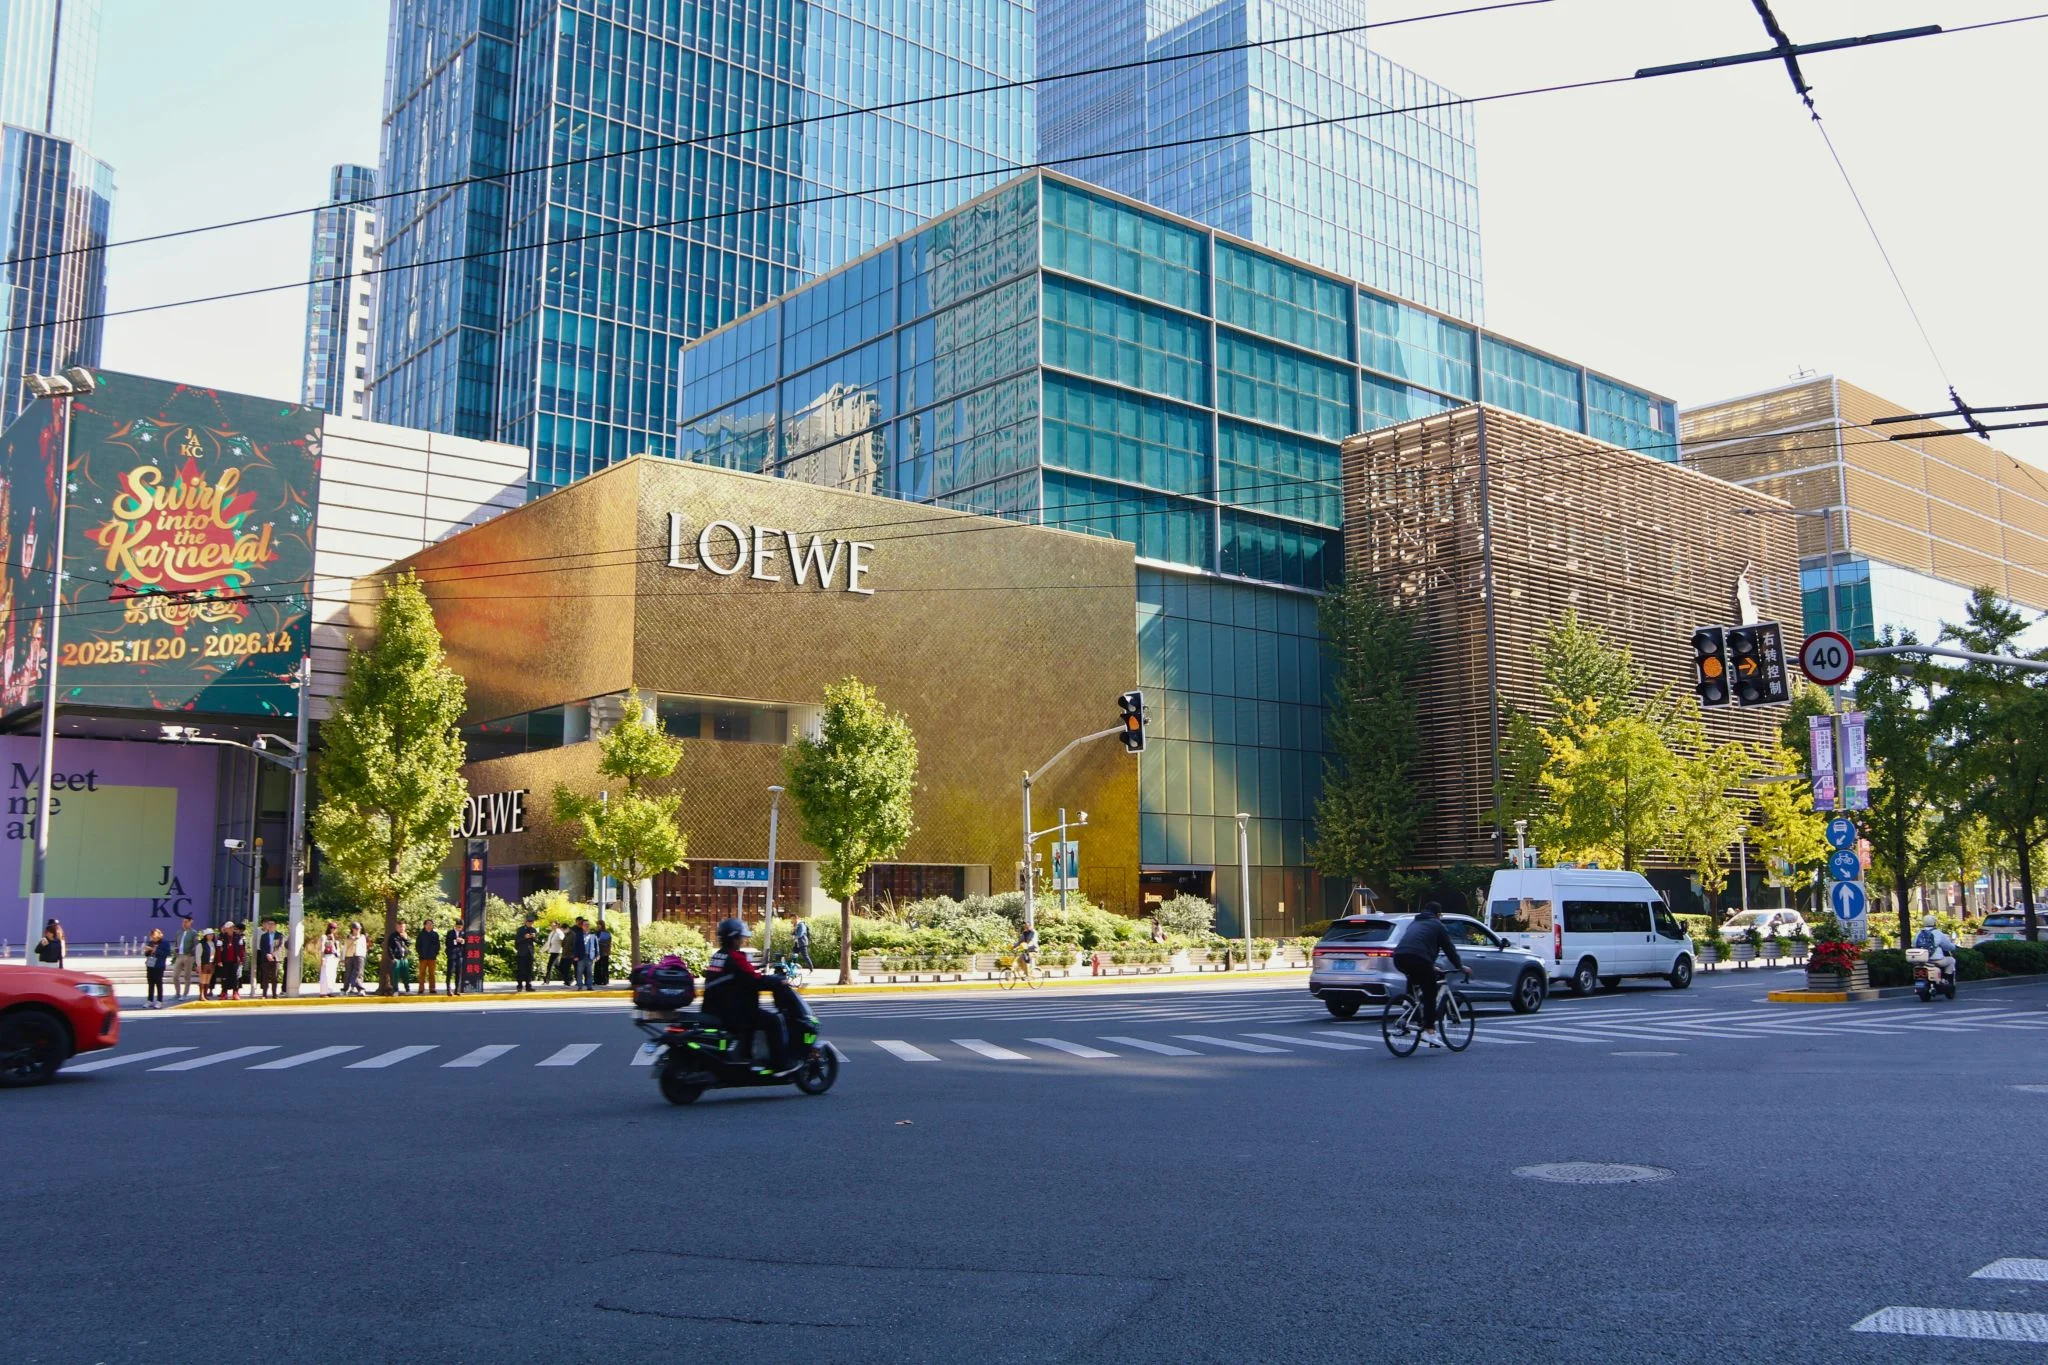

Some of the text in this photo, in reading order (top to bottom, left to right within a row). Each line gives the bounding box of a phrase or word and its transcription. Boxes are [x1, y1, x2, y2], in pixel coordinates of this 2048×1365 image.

[112, 465, 240, 529] Swirl
[156, 511, 211, 531] into
[98, 521, 273, 585] Karneval
[174, 531, 207, 545] the
[667, 512, 875, 595] LOEWE
[63, 637, 186, 666] 2025.11.20
[204, 631, 292, 657] 2026.1.4
[1763, 632, 1782, 695] 右转控制
[1812, 646, 1841, 670] 40
[10, 762, 98, 792] Meet
[7, 796, 61, 816] me
[6, 818, 36, 840] at
